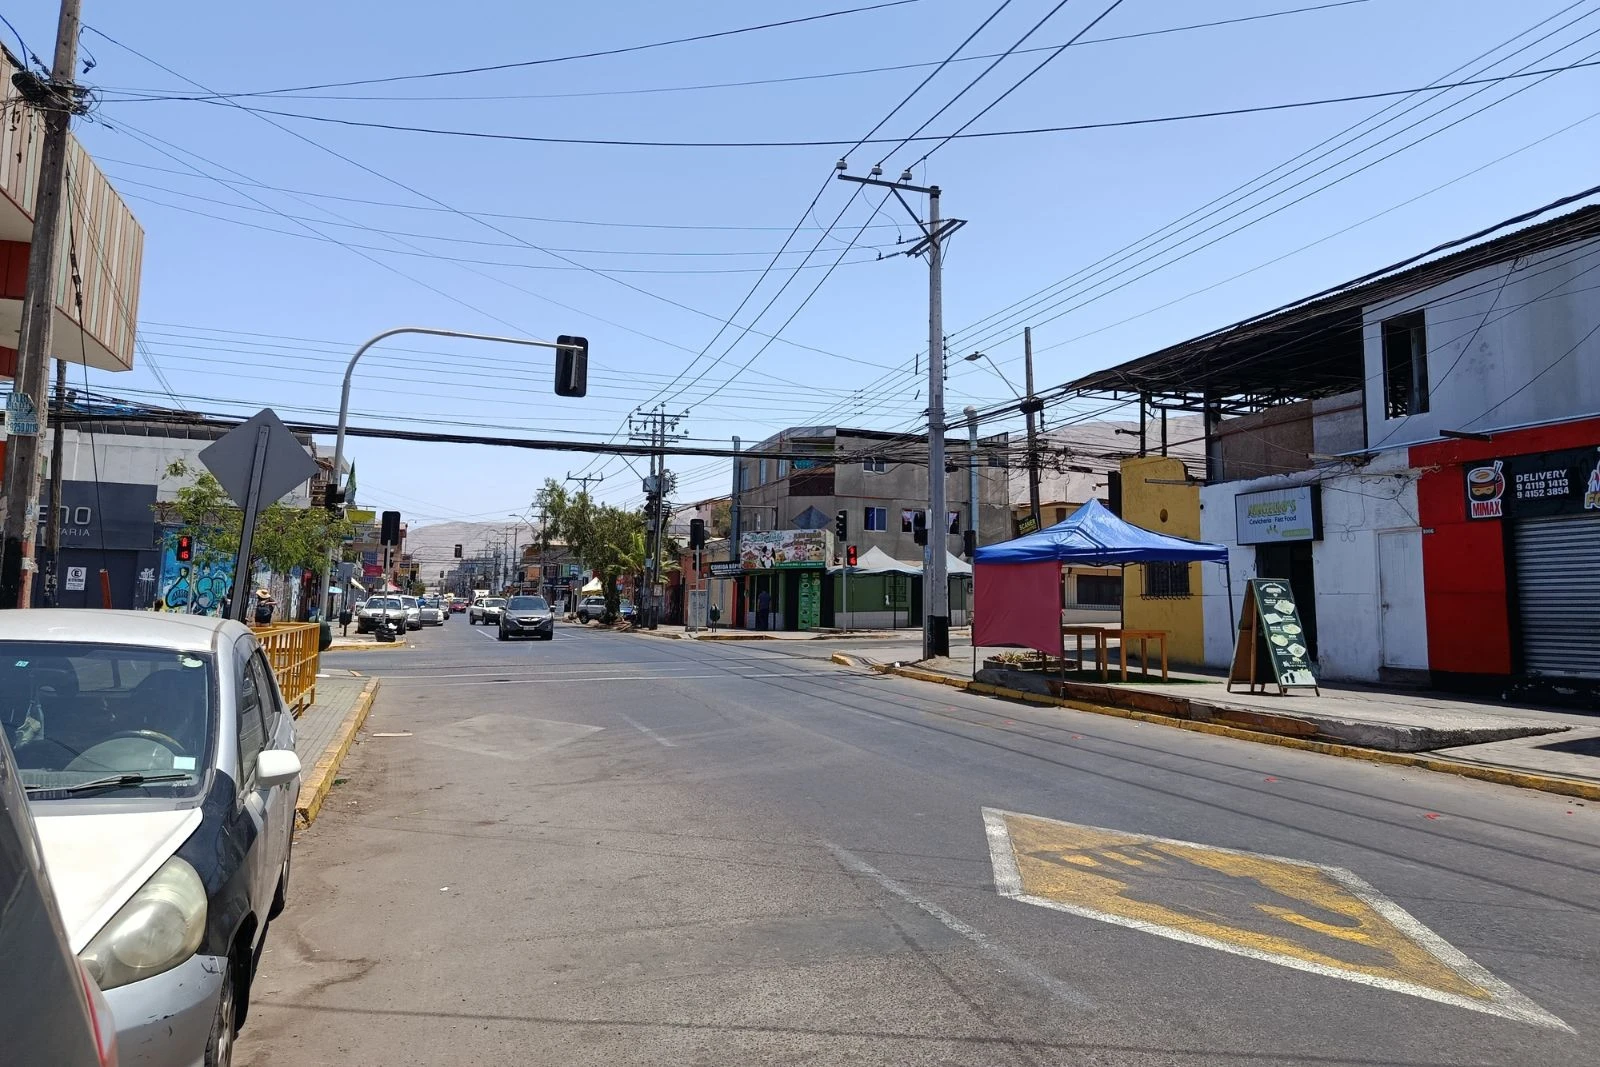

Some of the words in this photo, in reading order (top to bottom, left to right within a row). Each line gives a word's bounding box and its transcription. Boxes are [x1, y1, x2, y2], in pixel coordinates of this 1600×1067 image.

[1516, 469, 1567, 483] DELIVERY
[1516, 483, 1523, 491] 9
[1525, 481, 1545, 490] 4119
[1548, 478, 1568, 487] 1413
[1517, 491, 1523, 499] 9
[1525, 489, 1545, 498] 4152
[1547, 487, 1569, 496] 3854
[1472, 501, 1501, 517] MIMAX
[181, 551, 189, 559] 16
